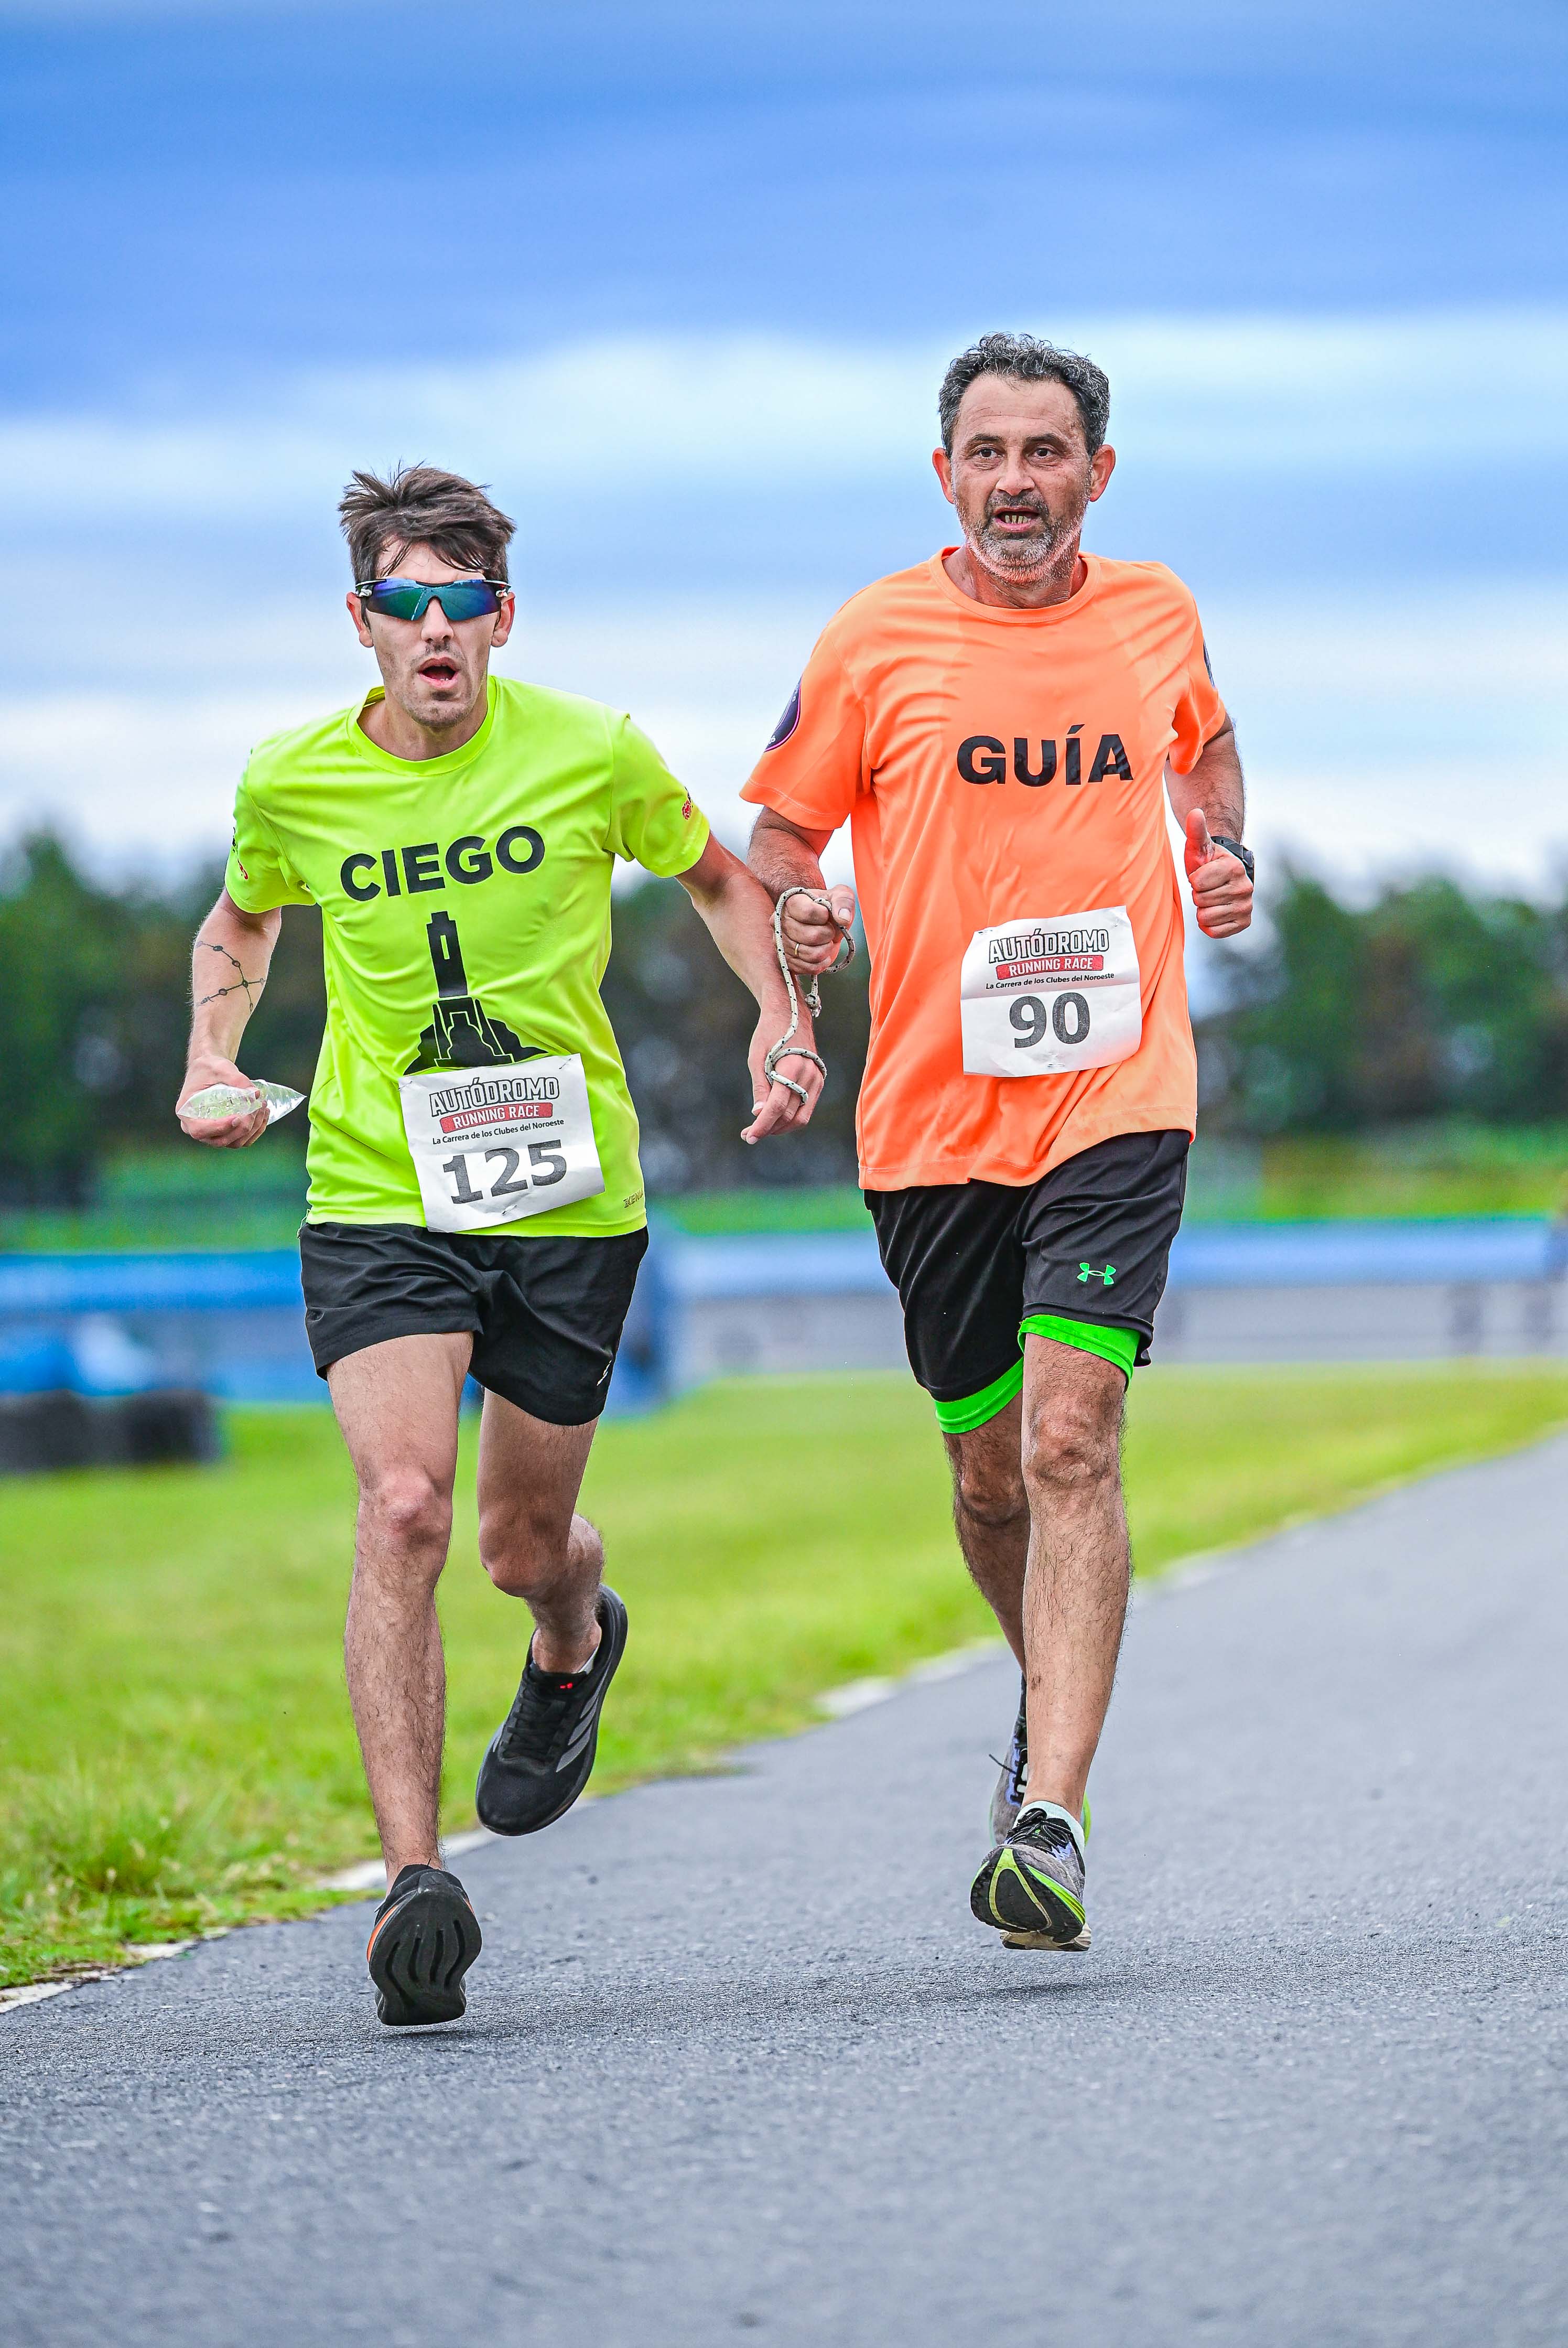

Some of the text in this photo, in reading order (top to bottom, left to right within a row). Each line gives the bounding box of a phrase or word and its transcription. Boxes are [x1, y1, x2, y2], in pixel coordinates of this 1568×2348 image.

[957, 724, 1134, 788] GUÍA
[340, 826, 545, 901] CIEGO
[989, 928, 1110, 964] AUTÓDROMO
[1009, 957, 1093, 977] RUNNING RACE
[1046, 975, 1070, 984] Clubes
[1084, 973, 1115, 981] Noroeste
[1009, 992, 1090, 1048] 90
[429, 1077, 559, 1117] AUTÓDROMO
[442, 1134, 469, 1143] Carrera
[494, 1127, 518, 1136] Clubes
[533, 1119, 564, 1129] Noroeste
[452, 1105, 540, 1129] RUNNING RACE
[443, 1139, 566, 1204] 125
